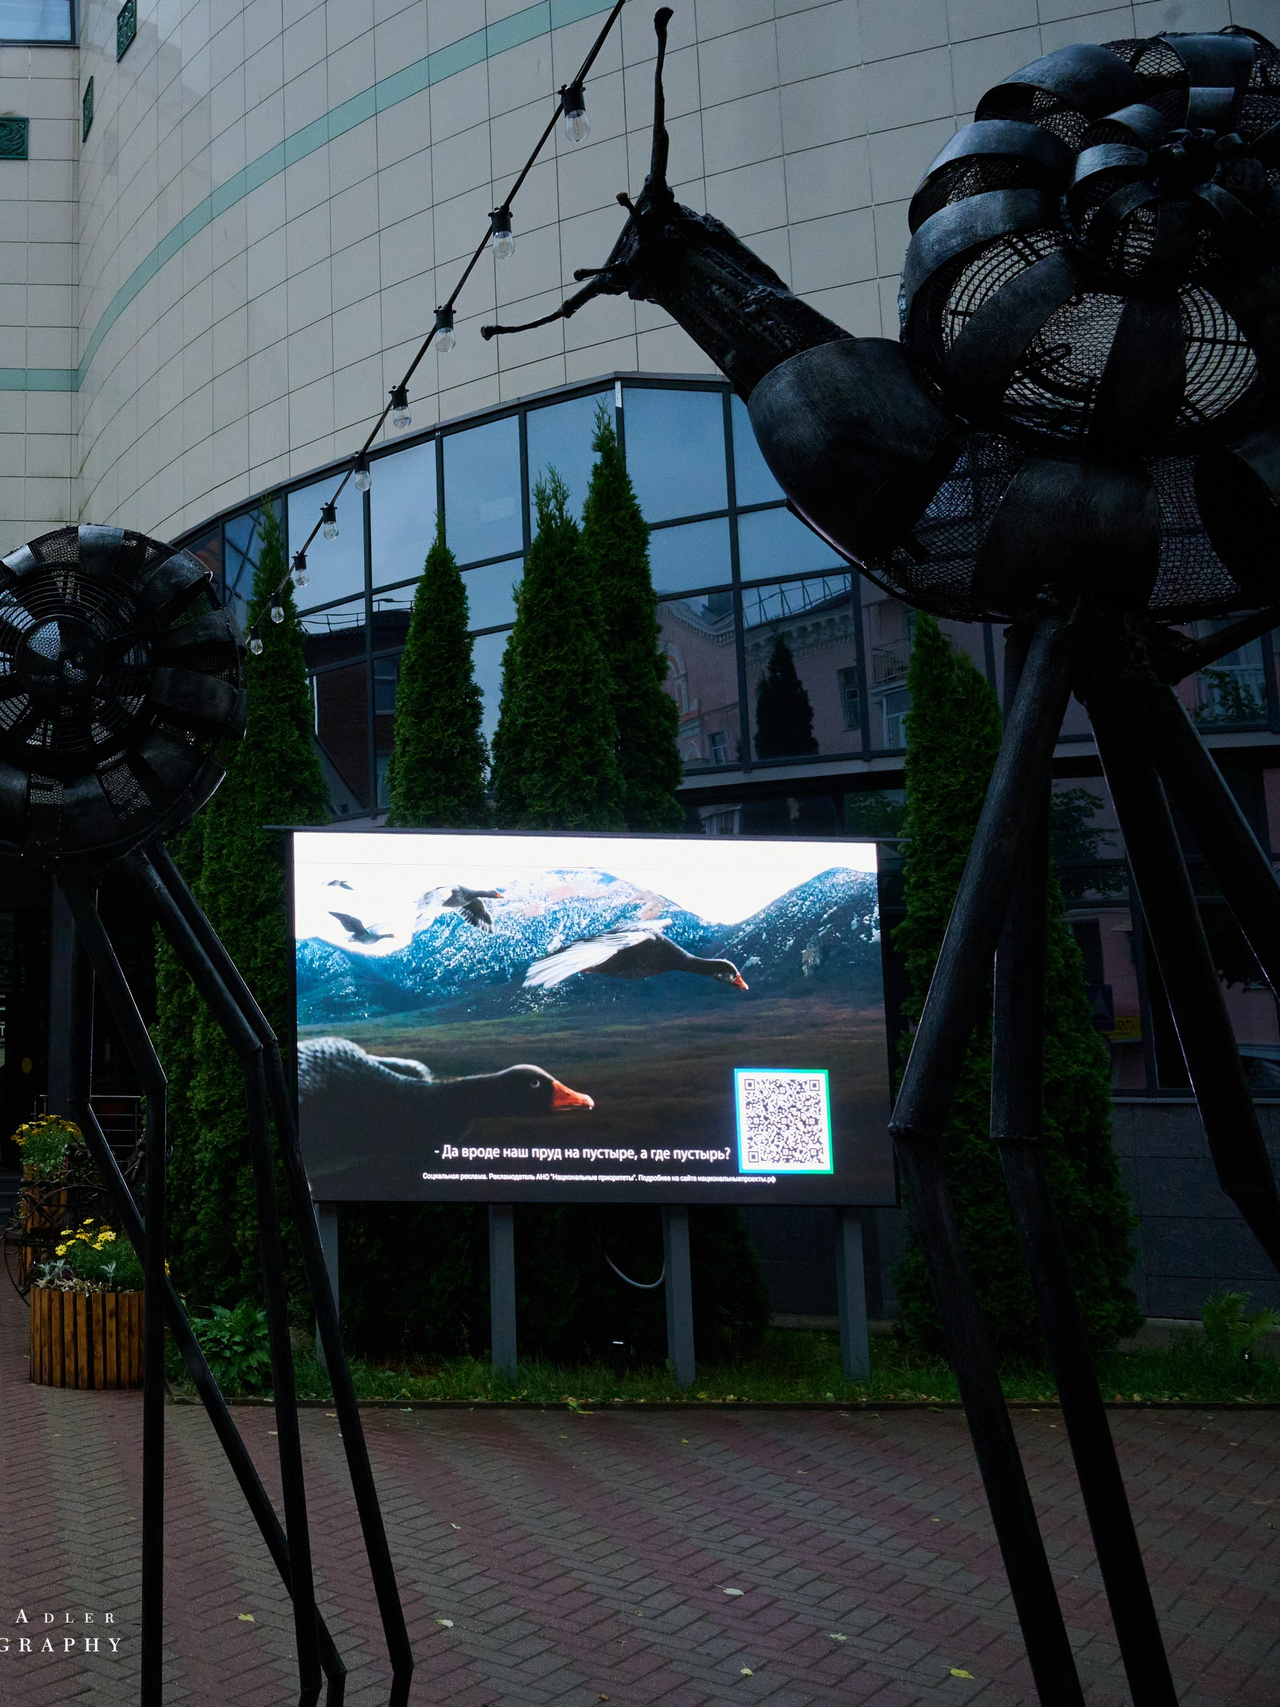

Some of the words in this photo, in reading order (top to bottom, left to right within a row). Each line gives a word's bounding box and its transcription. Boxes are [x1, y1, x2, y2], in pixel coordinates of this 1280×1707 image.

[442, 1144, 459, 1160] Да
[461, 1148, 500, 1161] вроде
[503, 1148, 529, 1159] наш
[531, 1148, 563, 1162] пруд
[564, 1149, 580, 1160] на
[582, 1149, 638, 1162] пустыре,
[639, 1149, 648, 1159] а
[650, 1150, 671, 1161] где
[673, 1147, 731, 1162] пустырь?
[422, 1172, 460, 1181] Социальная
[460, 1173, 488, 1182] реклама.
[488, 1172, 536, 1182] Рекламодатель
[536, 1173, 550, 1181] АНО
[638, 1174, 671, 1183] Подробнее
[680, 1174, 698, 1182] сайте
